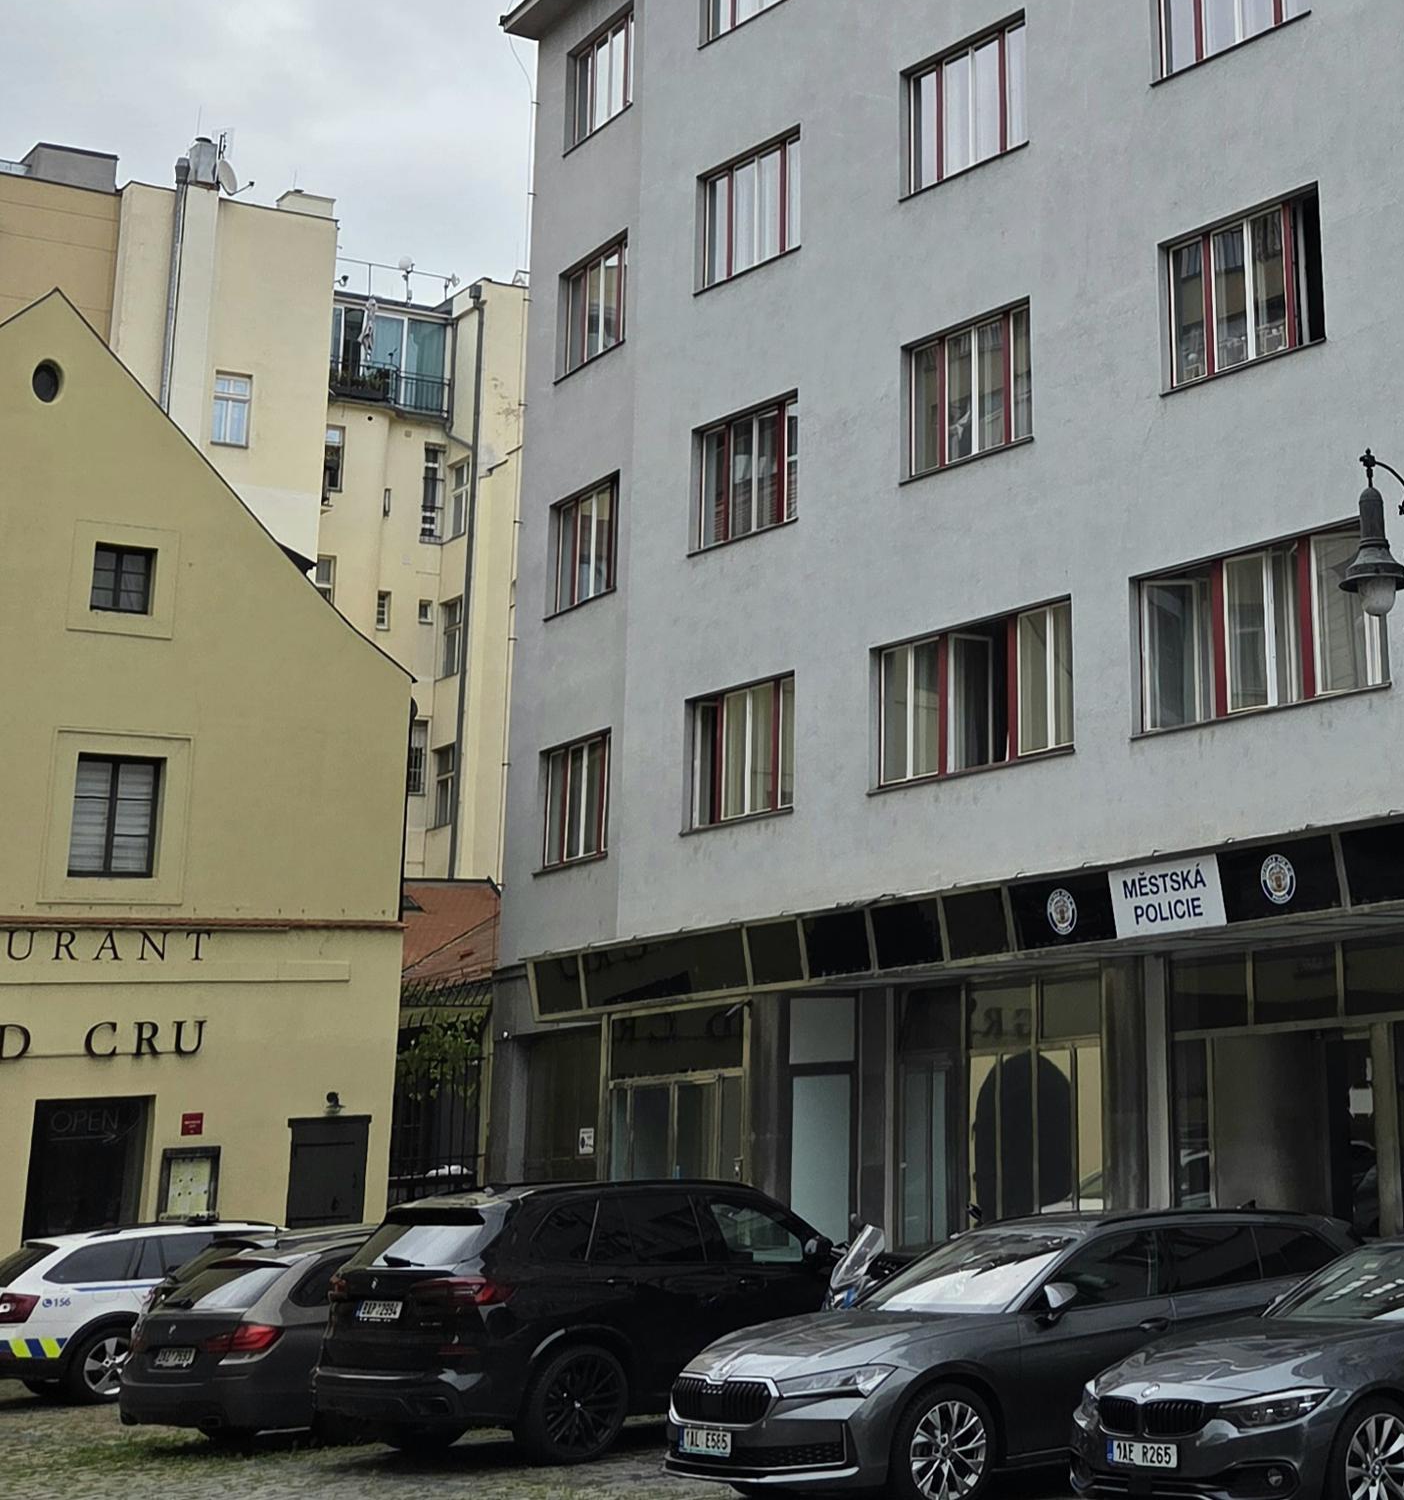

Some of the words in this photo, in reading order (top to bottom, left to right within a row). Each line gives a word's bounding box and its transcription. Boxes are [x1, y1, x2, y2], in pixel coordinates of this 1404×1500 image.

[1122, 863, 1207, 900] MĚSTSKÁ
[1133, 896, 1204, 925] POLICIE
[84, 1020, 207, 1059] CRU
[50, 1108, 120, 1133] OPEN
[53, 1296, 72, 1308] 156
[1116, 1442, 1135, 1462] 1AE
[1142, 1444, 1172, 1465] R265
